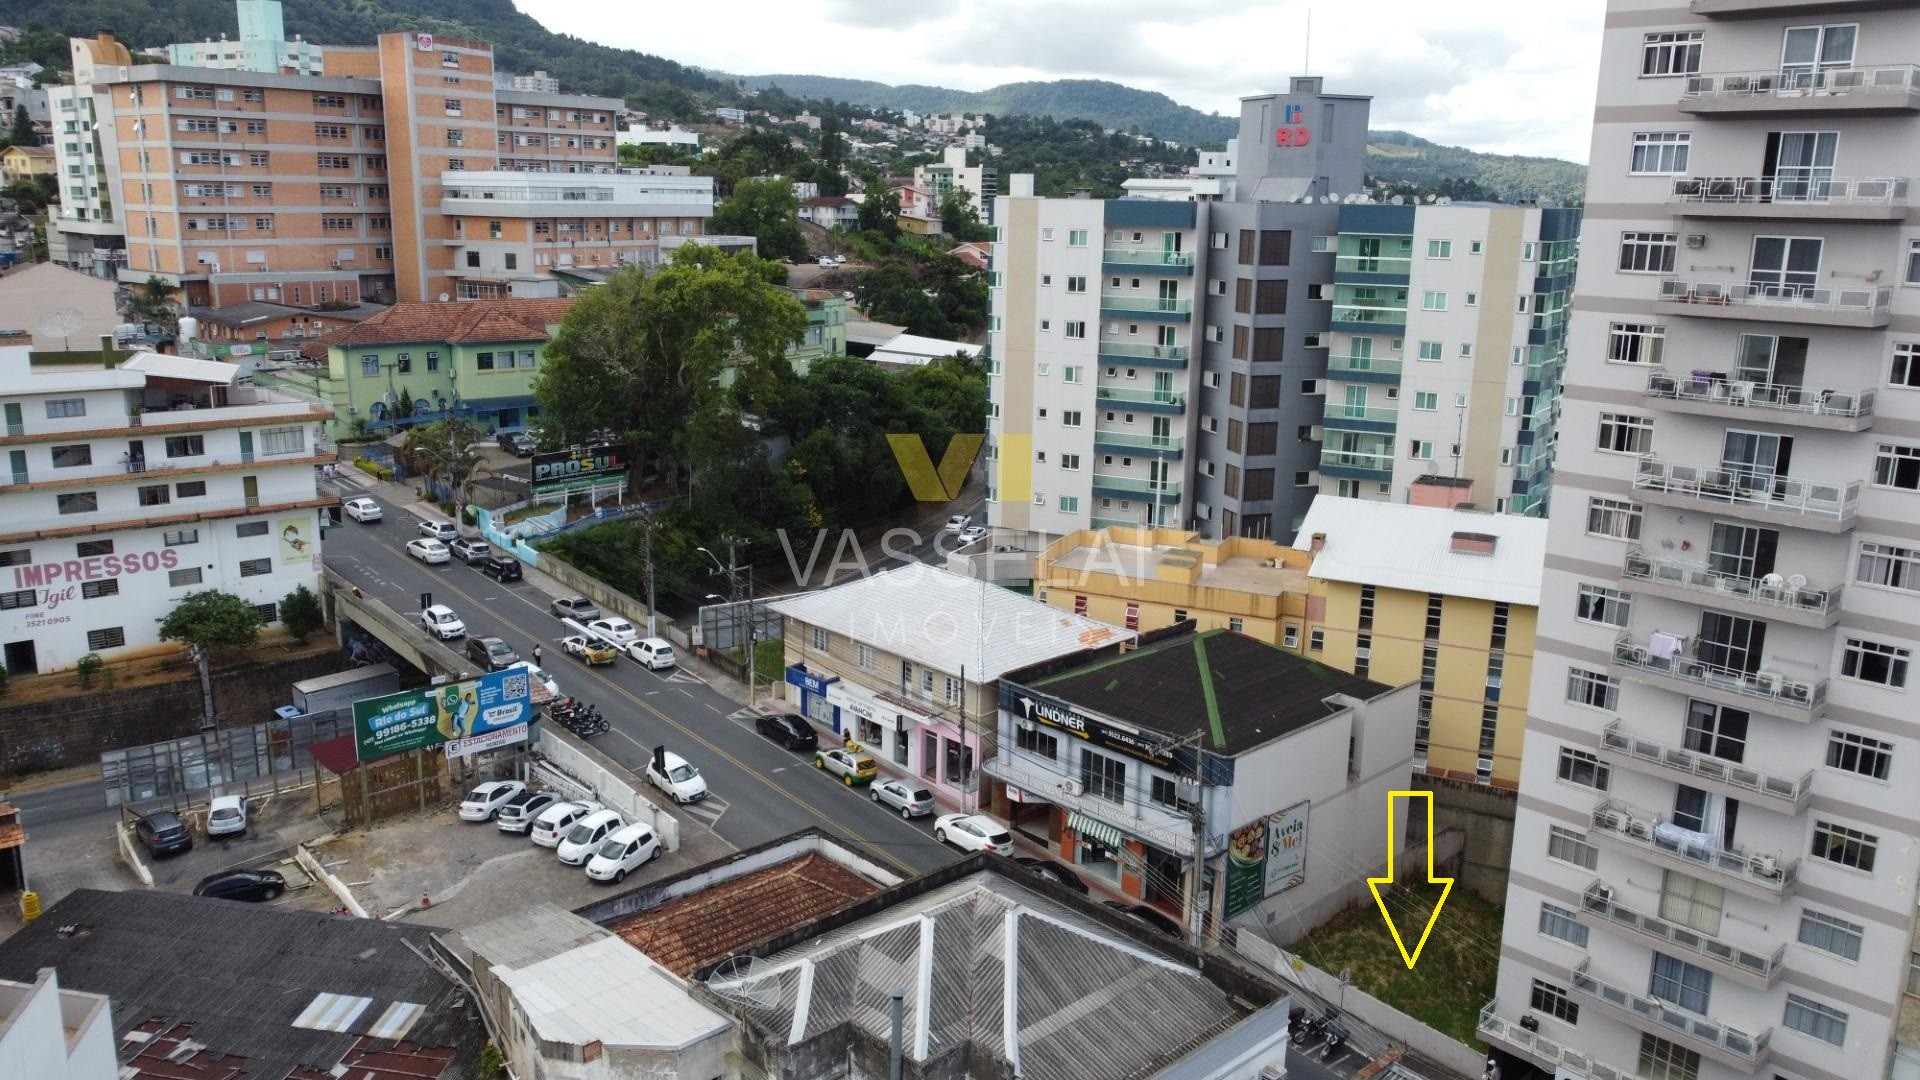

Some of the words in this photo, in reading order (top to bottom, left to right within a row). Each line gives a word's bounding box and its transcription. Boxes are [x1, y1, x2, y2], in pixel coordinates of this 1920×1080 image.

[1276, 127, 1311, 147] RD
[535, 455, 625, 479] PROSUL
[14, 549, 179, 589] IMPRESSOS
[374, 715, 392, 728] Rio
[394, 711, 407, 721] do
[409, 704, 426, 717] Sul
[381, 700, 416, 714] Whatsapp
[496, 705, 518, 717] Brasil
[1035, 702, 1085, 732] LINDNER
[375, 715, 436, 740] 99186-5338
[463, 725, 527, 747] ESTACIONAMENTO
